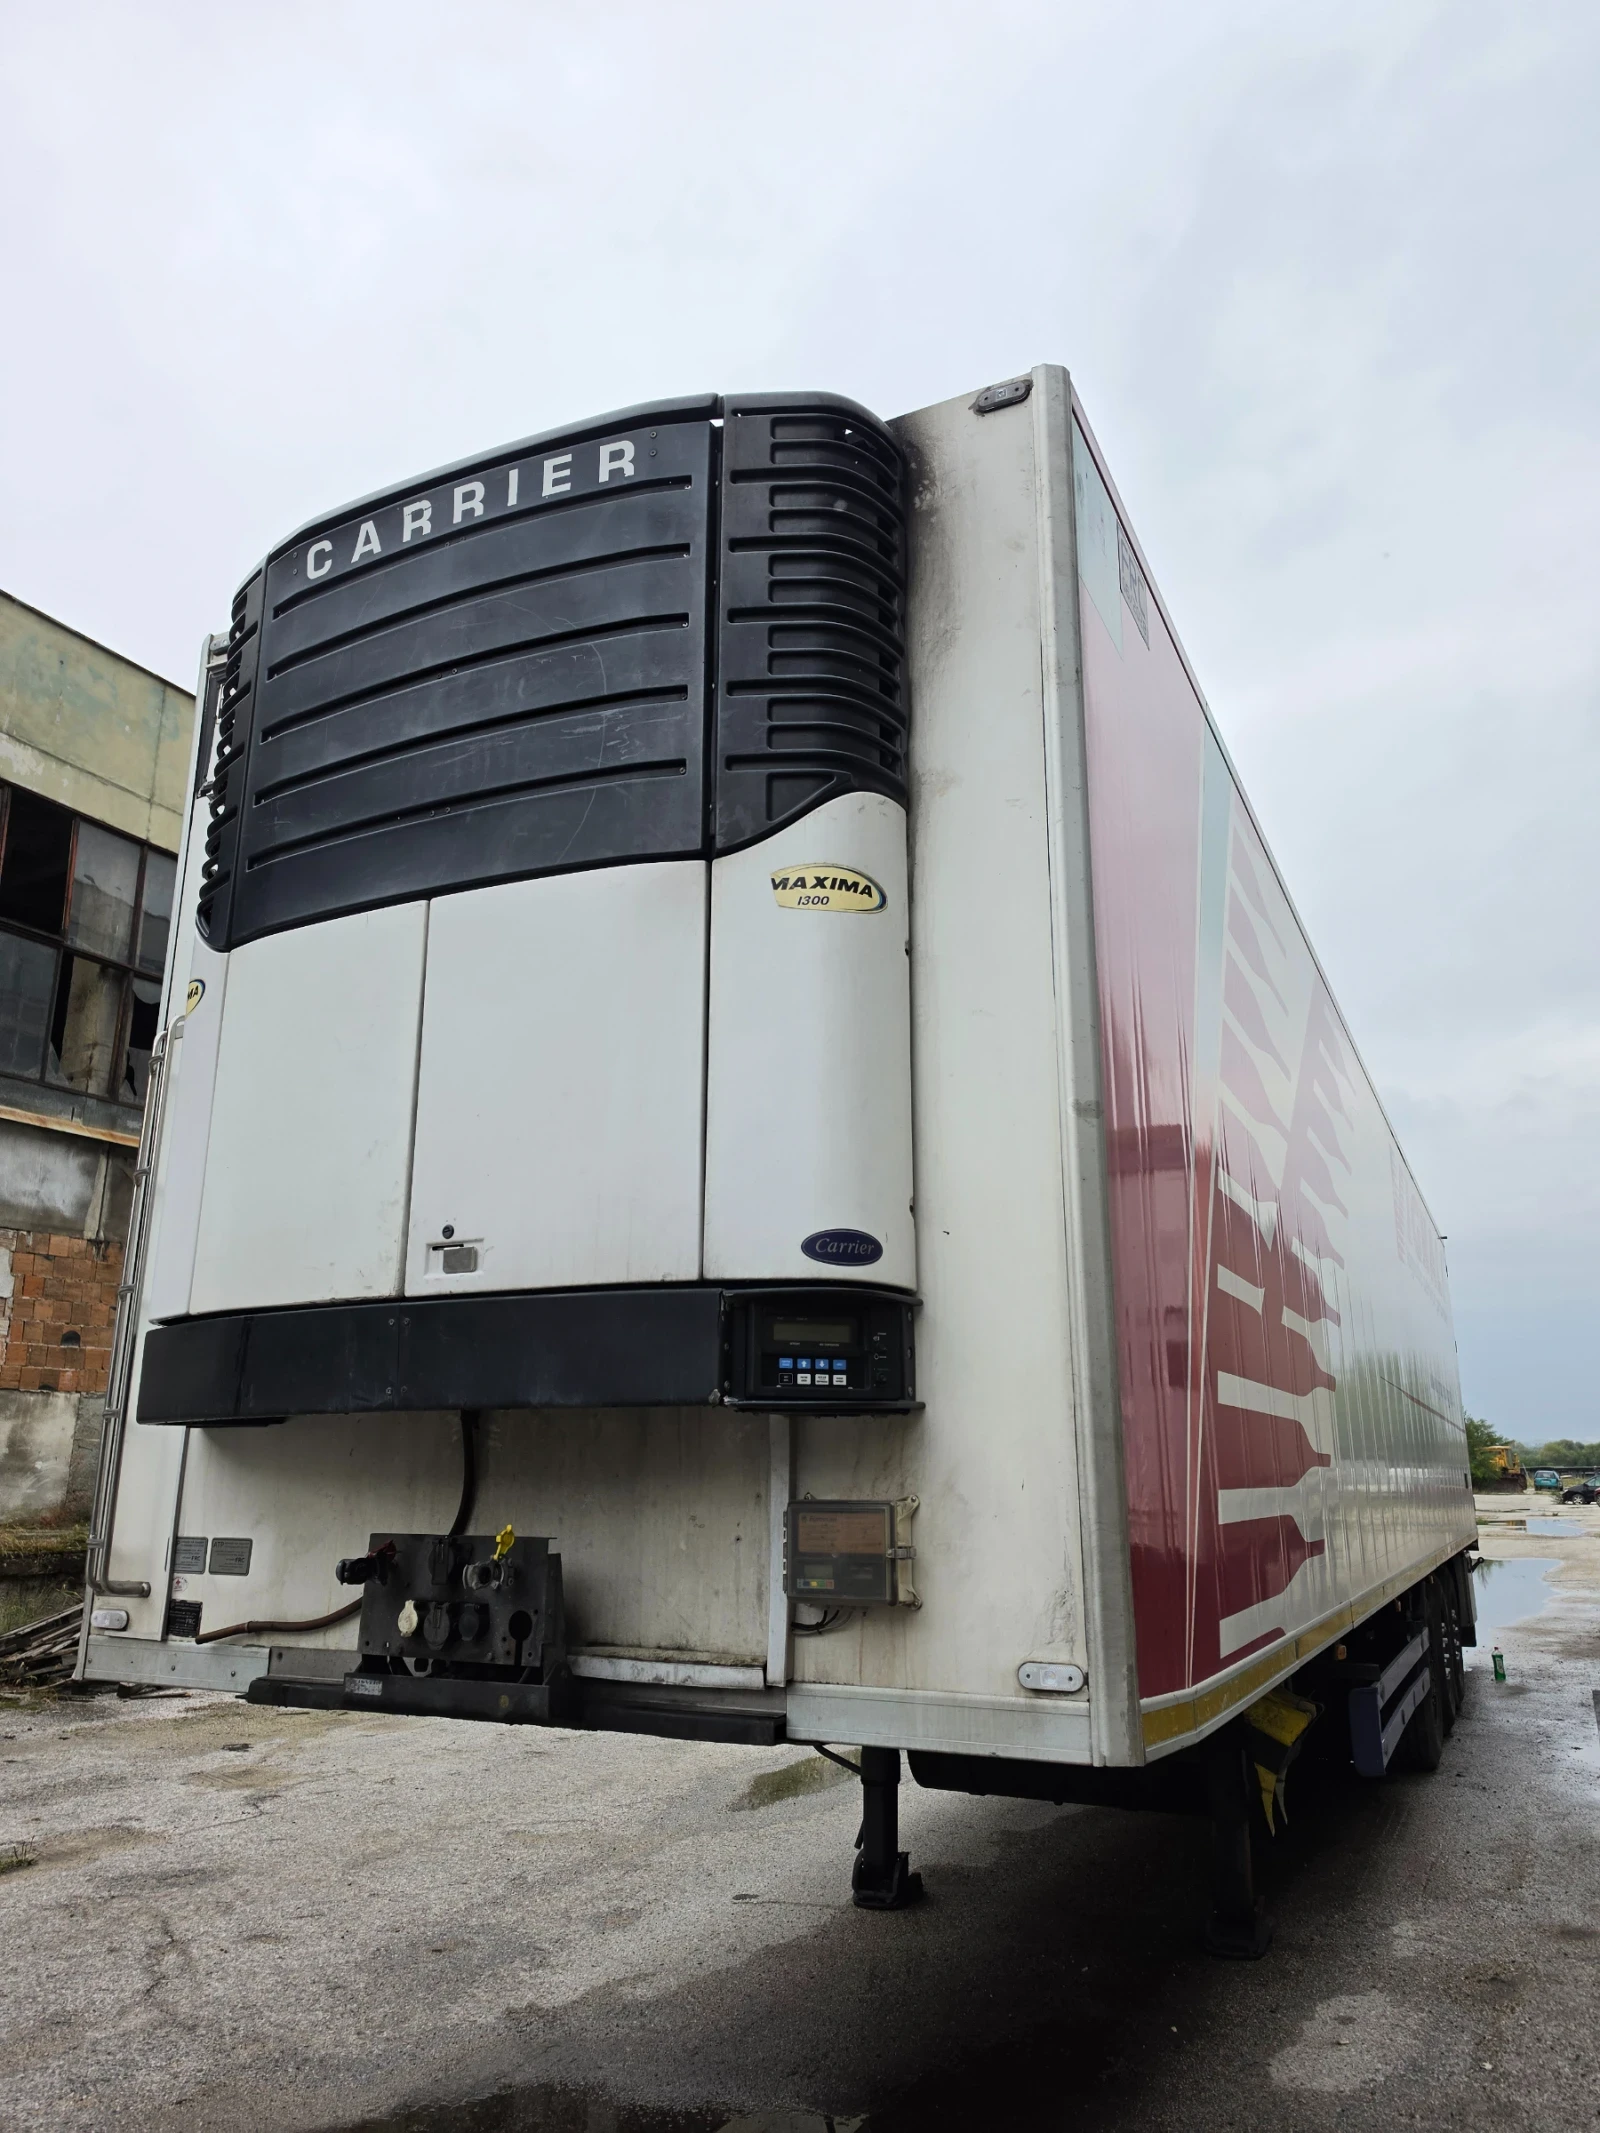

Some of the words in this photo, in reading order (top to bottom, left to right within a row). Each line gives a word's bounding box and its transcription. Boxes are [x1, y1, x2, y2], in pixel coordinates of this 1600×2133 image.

[306, 439, 637, 581] CARRIER
[770, 876, 873, 898] MAXIMA
[797, 895, 830, 906] 1300
[815, 1237, 875, 1255] Carrier
